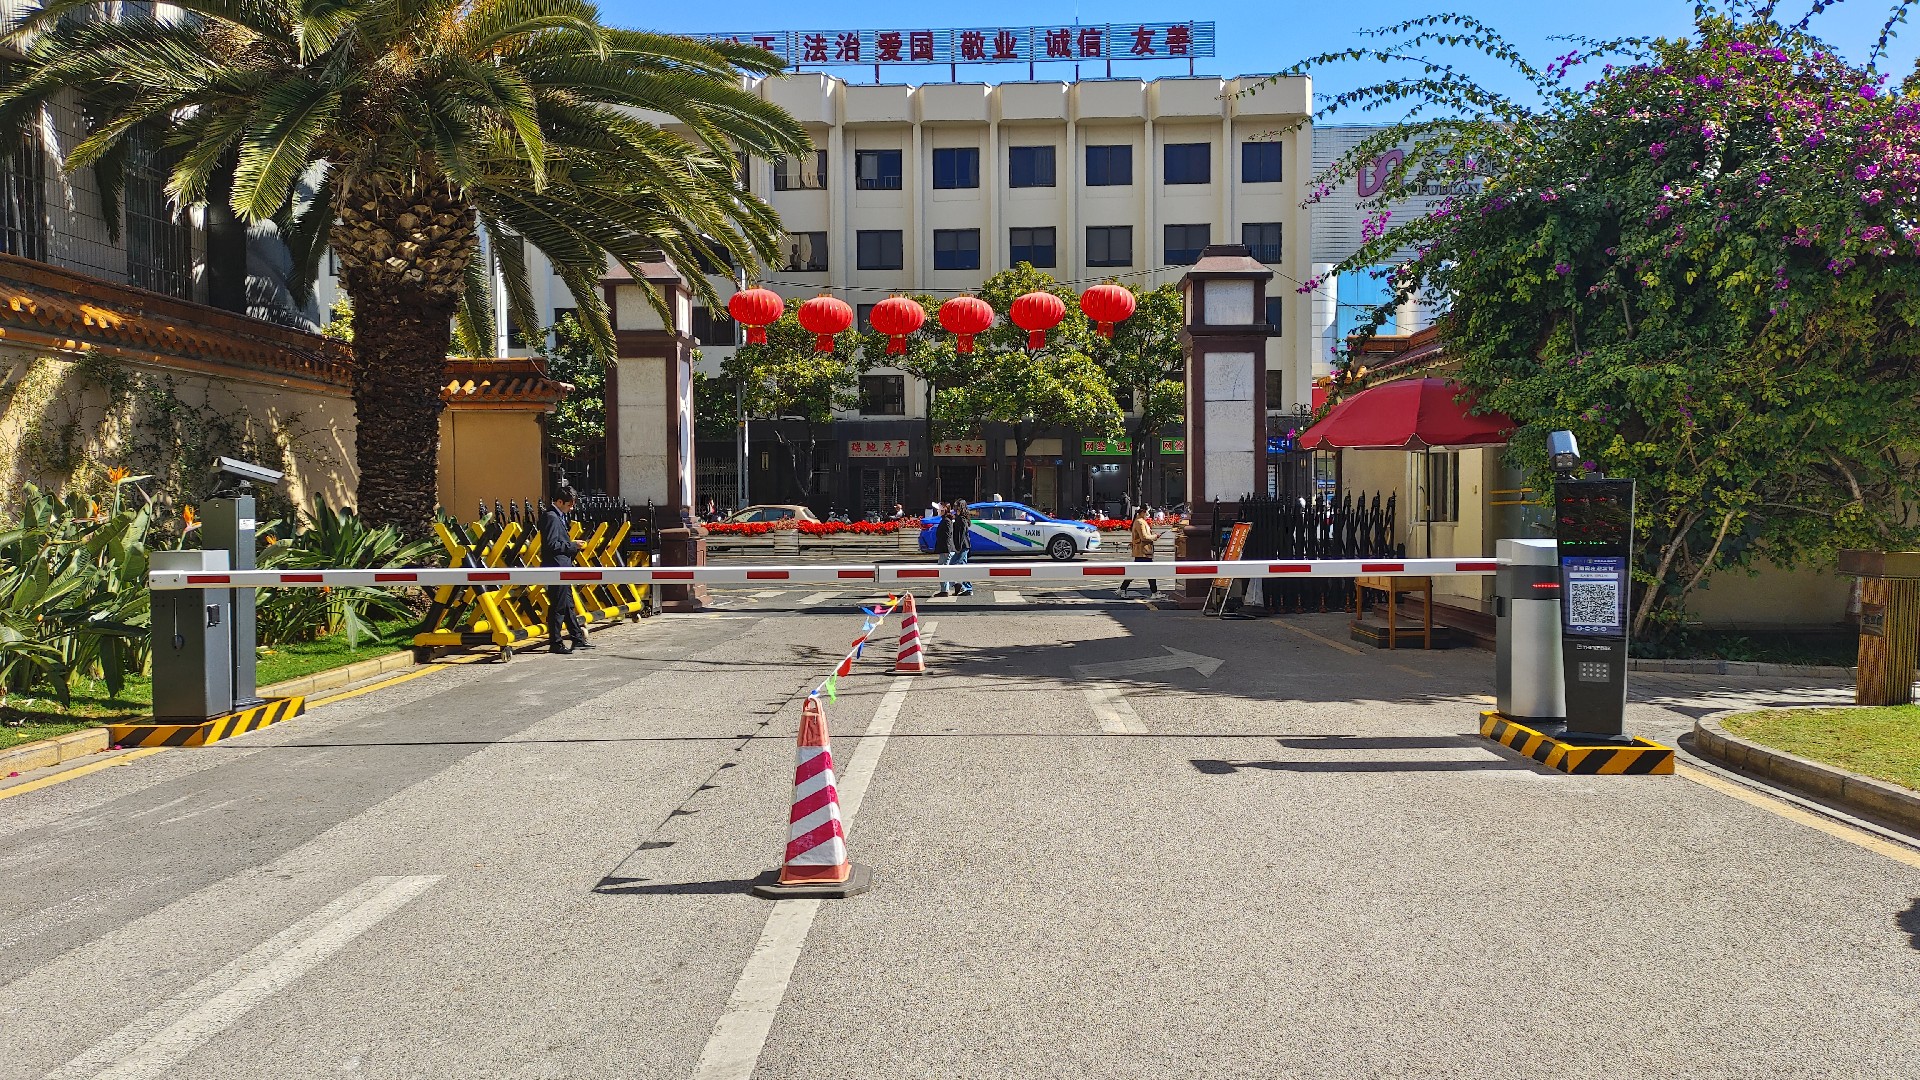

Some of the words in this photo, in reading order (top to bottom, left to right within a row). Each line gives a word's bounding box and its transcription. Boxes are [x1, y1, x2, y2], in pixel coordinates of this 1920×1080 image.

[803, 32, 861, 62] 法治
[877, 31, 934, 62] 爱国
[960, 29, 1018, 60] 敬业
[1045, 27, 1102, 58] 诚信
[1130, 24, 1191, 55] 友善
